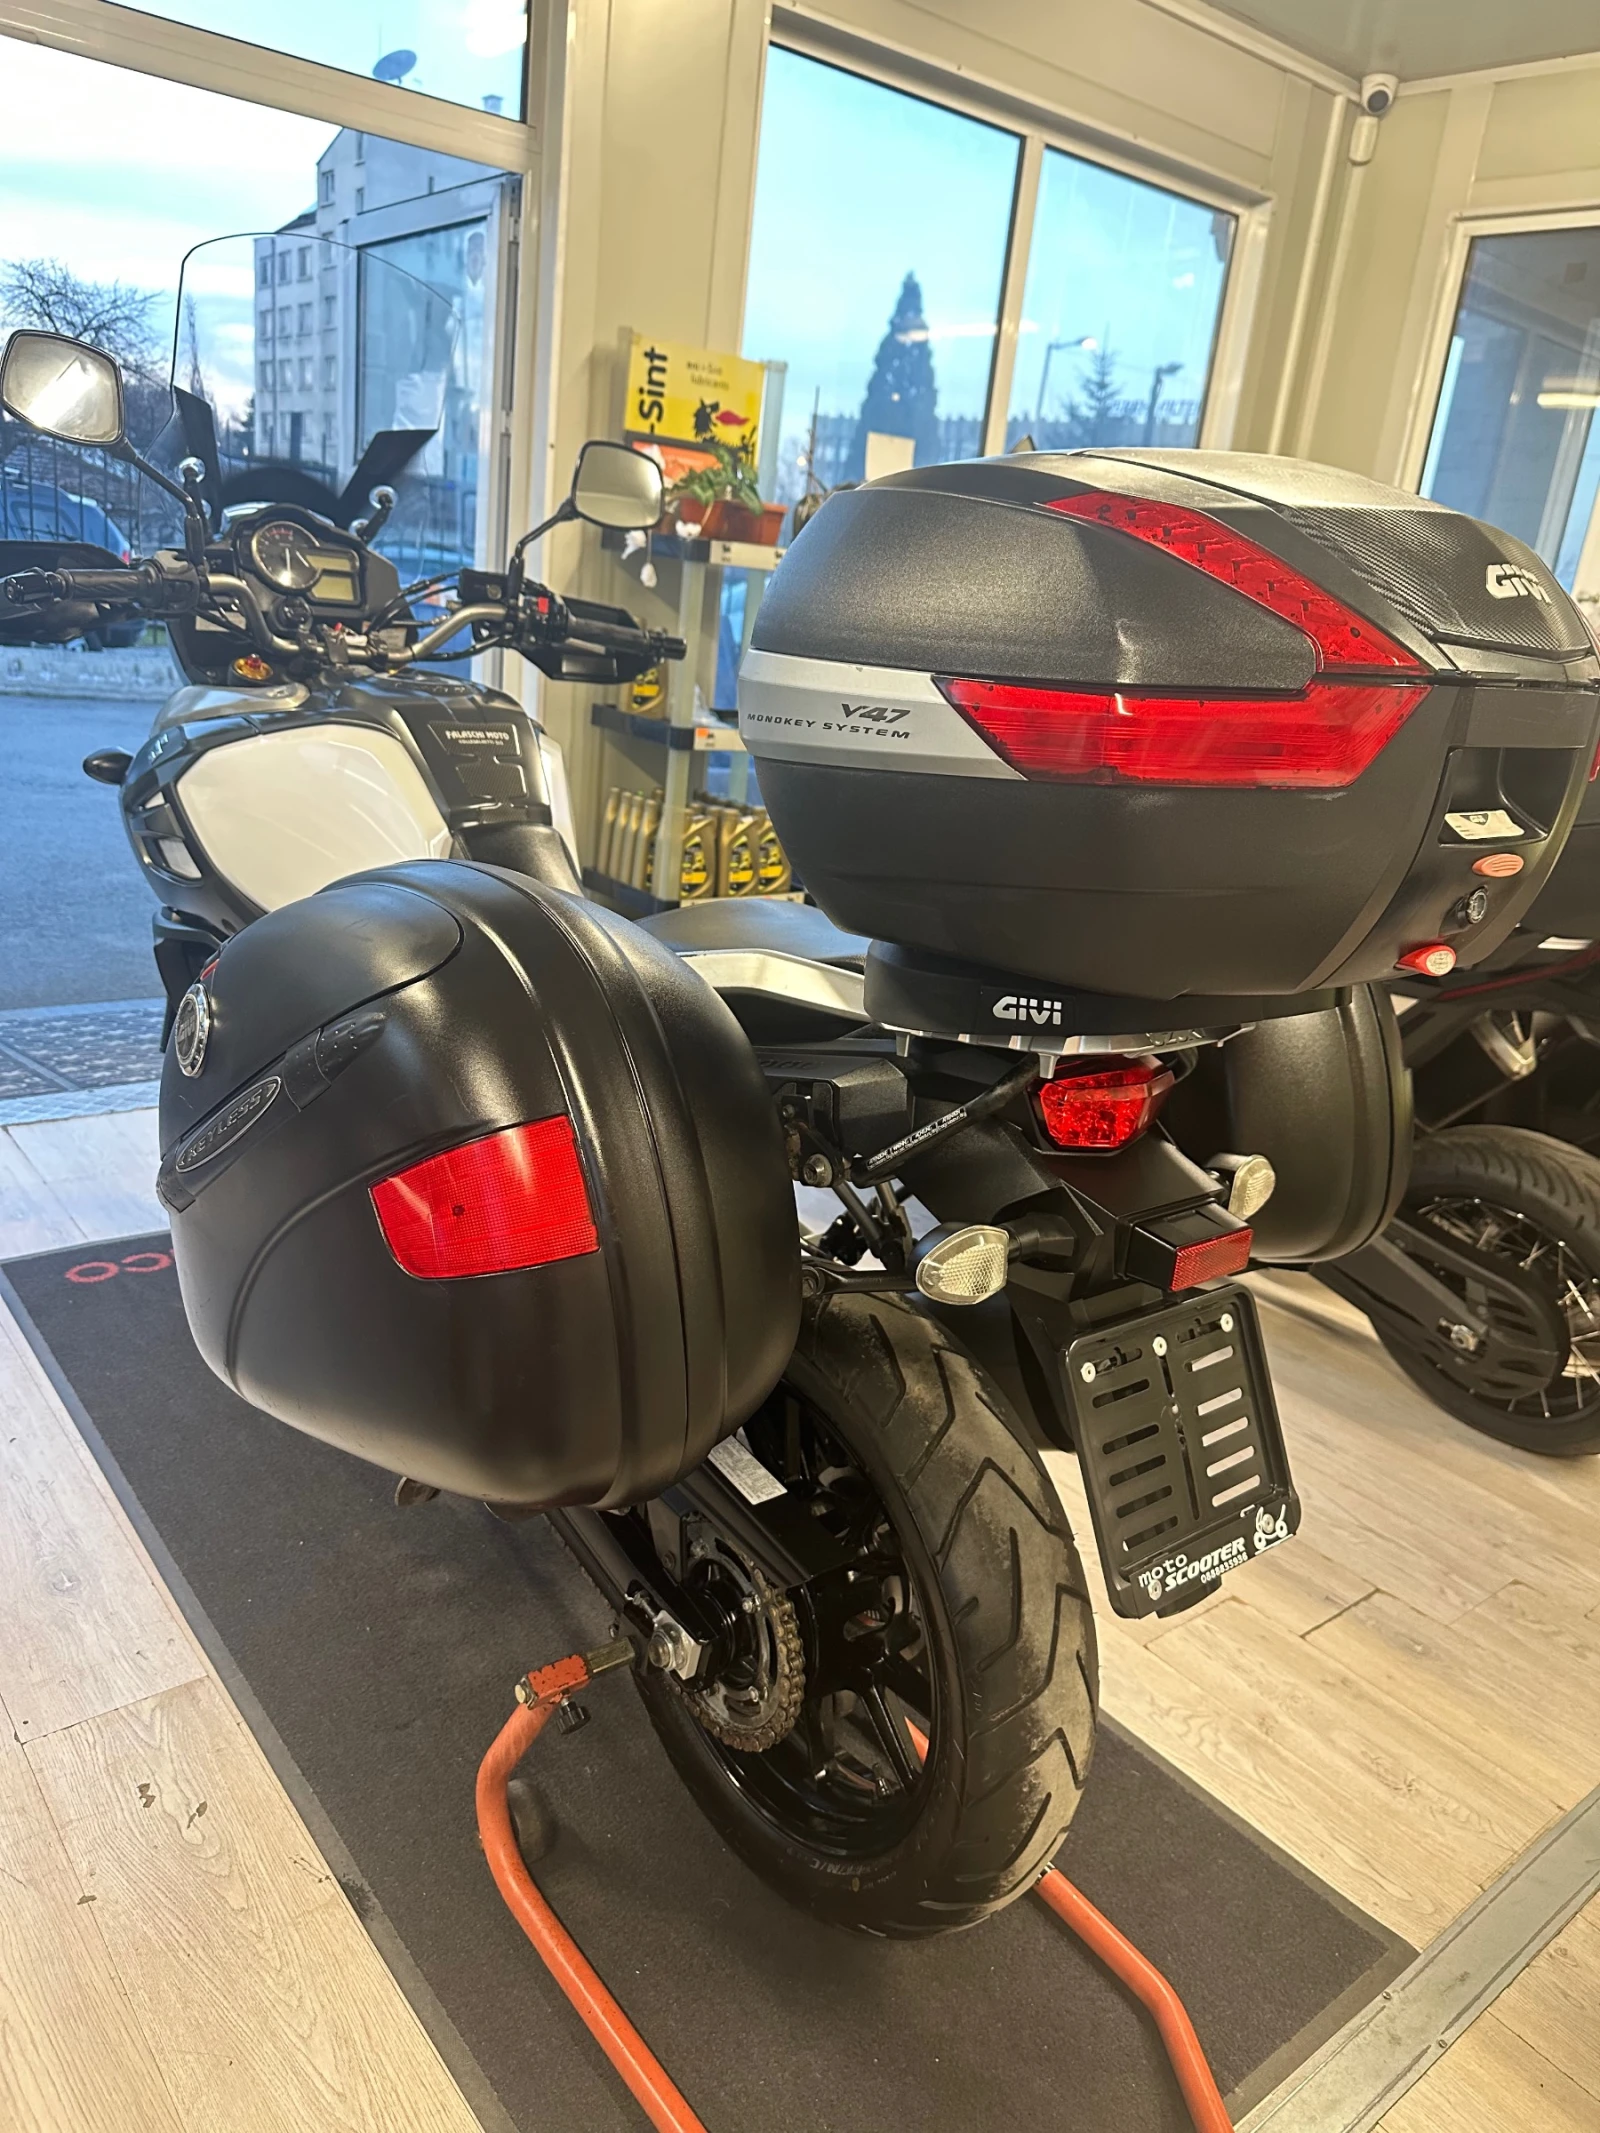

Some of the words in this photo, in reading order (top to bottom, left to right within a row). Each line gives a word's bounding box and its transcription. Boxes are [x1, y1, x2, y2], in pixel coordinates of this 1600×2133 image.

[1485, 563, 1552, 604] GIVI
[747, 713, 816, 727] MONOKEY
[822, 722, 911, 739] SYSTEM
[841, 703, 911, 723] V47
[486, 731, 510, 740] MOTO
[992, 995, 1062, 1026] GIVI
[187, 1088, 263, 1163] KEYLESS
[1138, 1553, 1188, 1588] moto
[1164, 1536, 1246, 1592] SCOOTER
